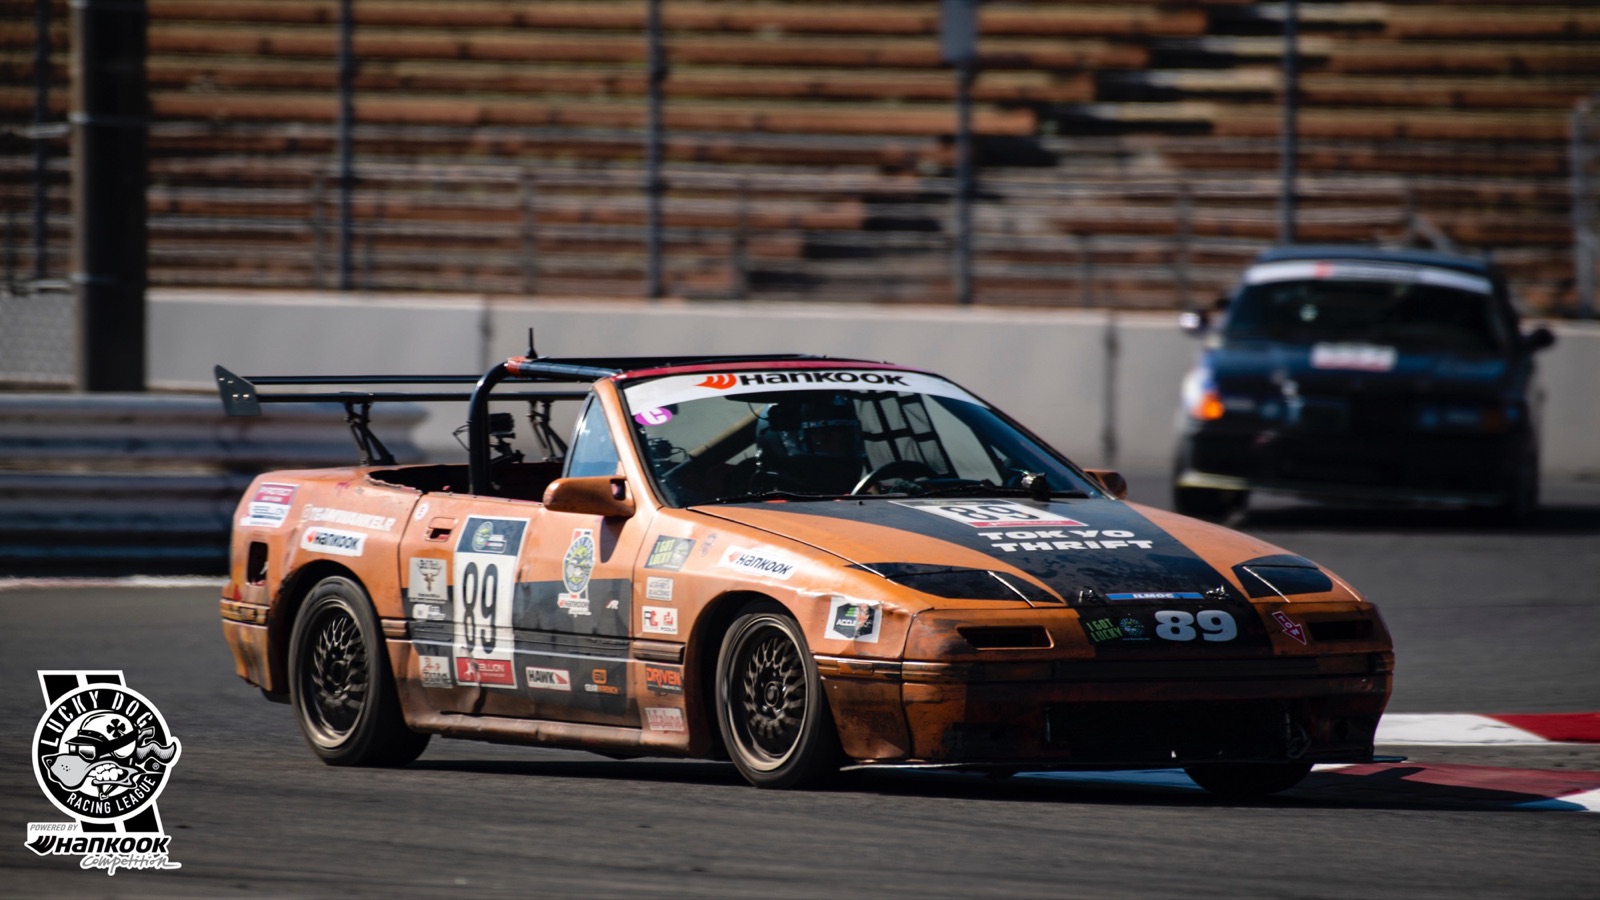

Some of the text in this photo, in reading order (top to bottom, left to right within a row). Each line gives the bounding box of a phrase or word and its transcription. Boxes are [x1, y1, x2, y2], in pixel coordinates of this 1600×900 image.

[940, 506, 1040, 520] 89
[977, 530, 1135, 540] TOKYO
[991, 540, 1153, 552] THRIFT
[463, 562, 499, 655] 89
[1092, 618, 1114, 631] GOT
[1154, 610, 1238, 642] 89
[1090, 627, 1124, 643] LUCKY
[528, 670, 556, 684] HAWK
[646, 667, 682, 687] DRIVEN
